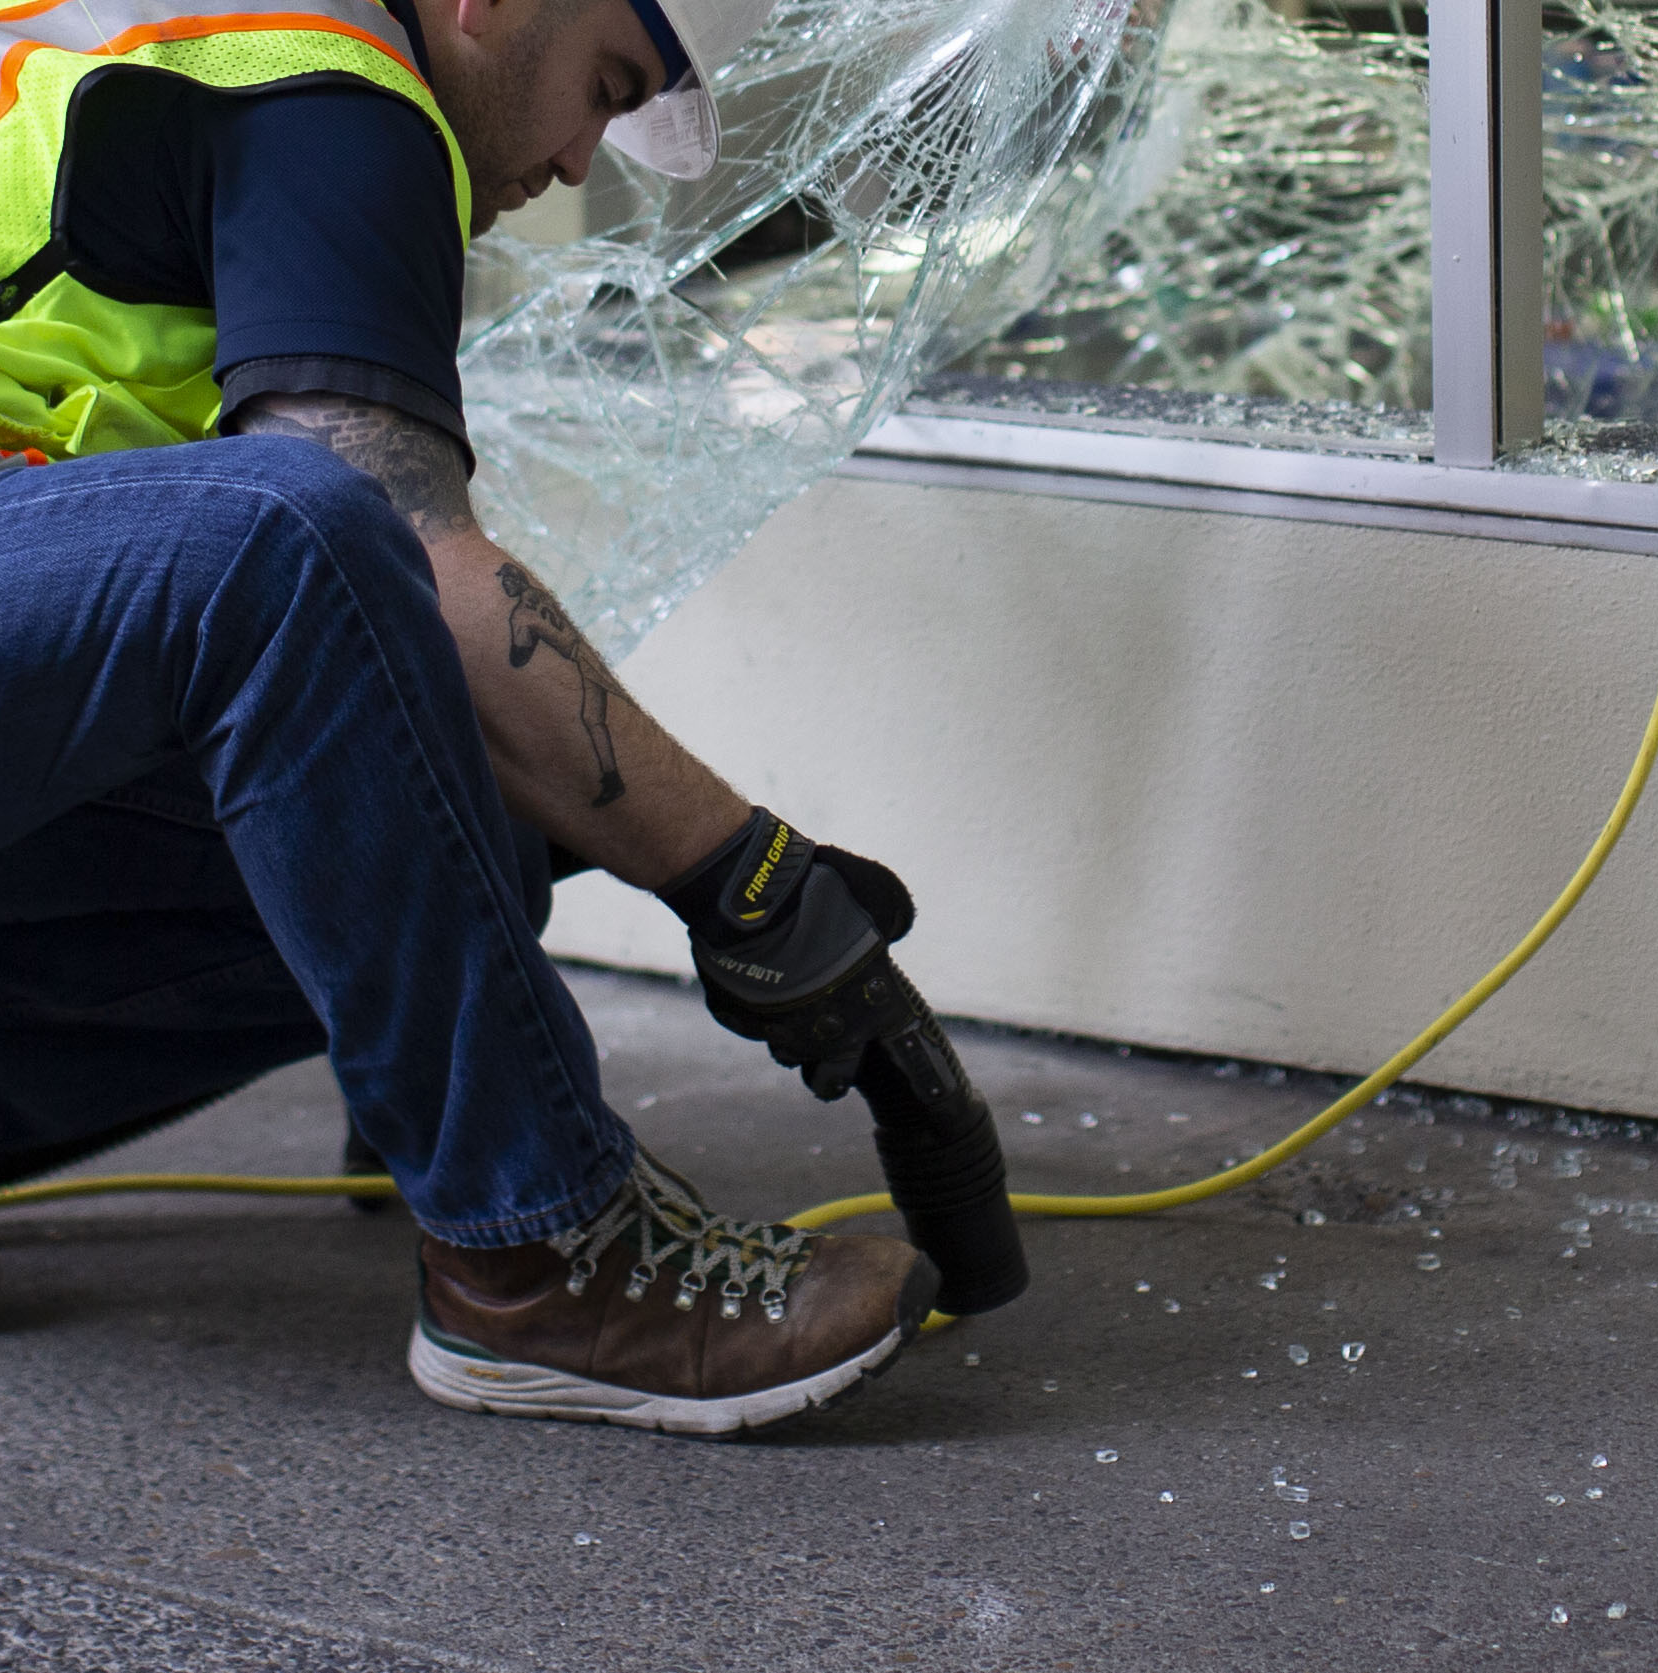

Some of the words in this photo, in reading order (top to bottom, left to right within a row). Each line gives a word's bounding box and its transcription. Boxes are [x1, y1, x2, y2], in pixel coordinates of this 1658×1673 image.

[744, 860, 775, 903] FIRM
[767, 823, 790, 865] GRIP
[746, 963, 785, 985] DUTY
